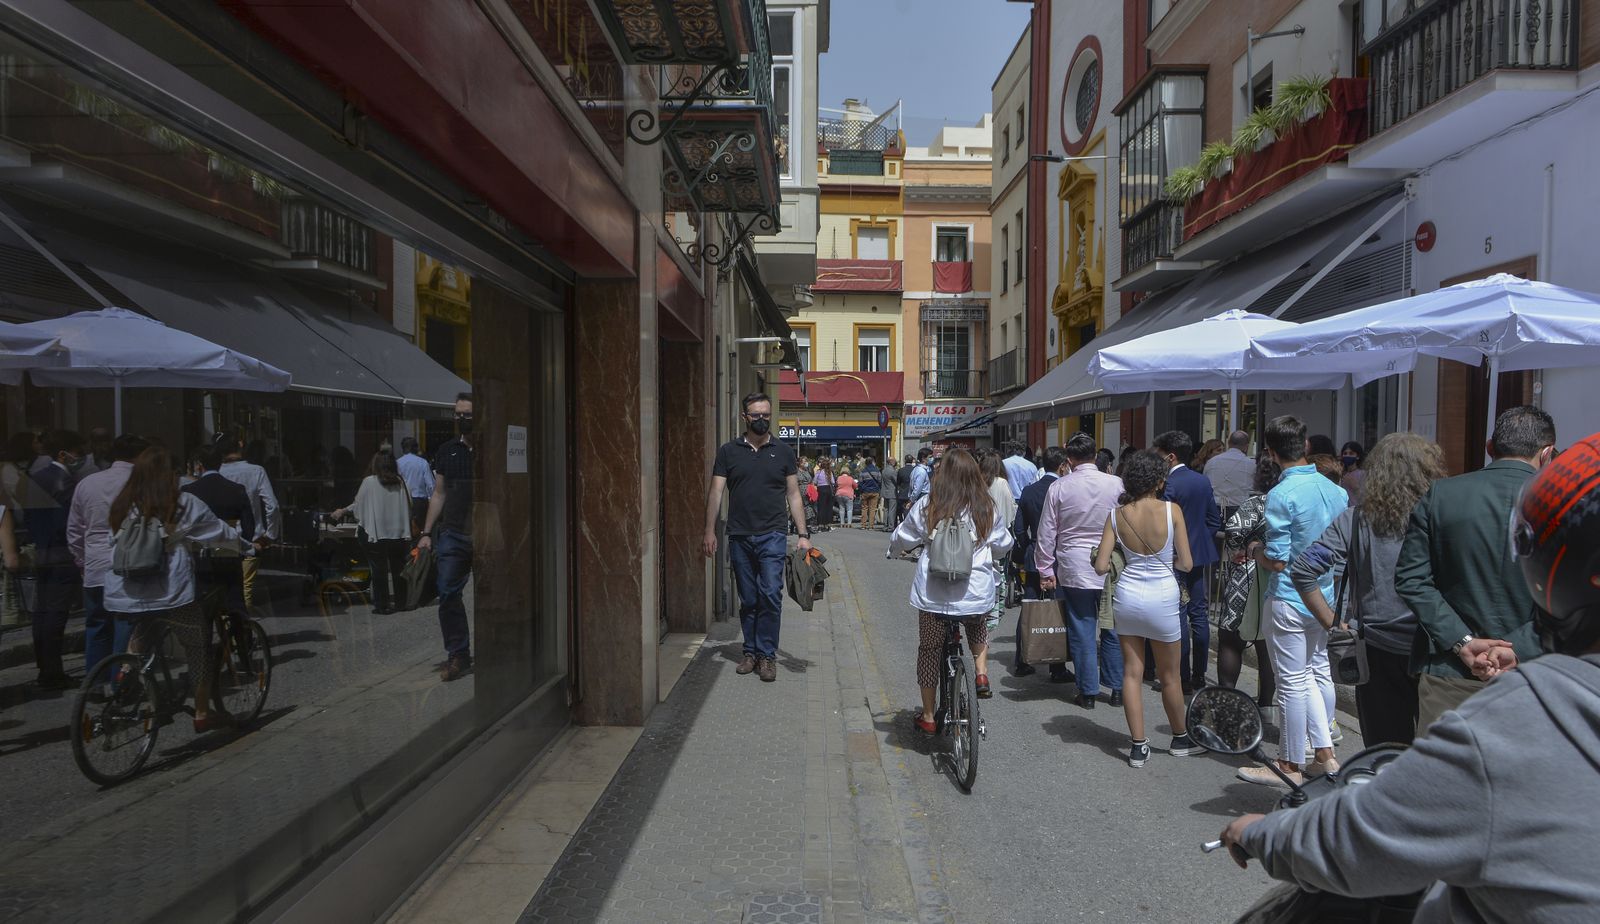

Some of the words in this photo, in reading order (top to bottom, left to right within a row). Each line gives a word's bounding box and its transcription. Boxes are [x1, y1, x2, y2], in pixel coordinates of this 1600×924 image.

[1484, 236, 1492, 254] 5
[912, 406, 927, 415] LA
[934, 406, 967, 415] CASA
